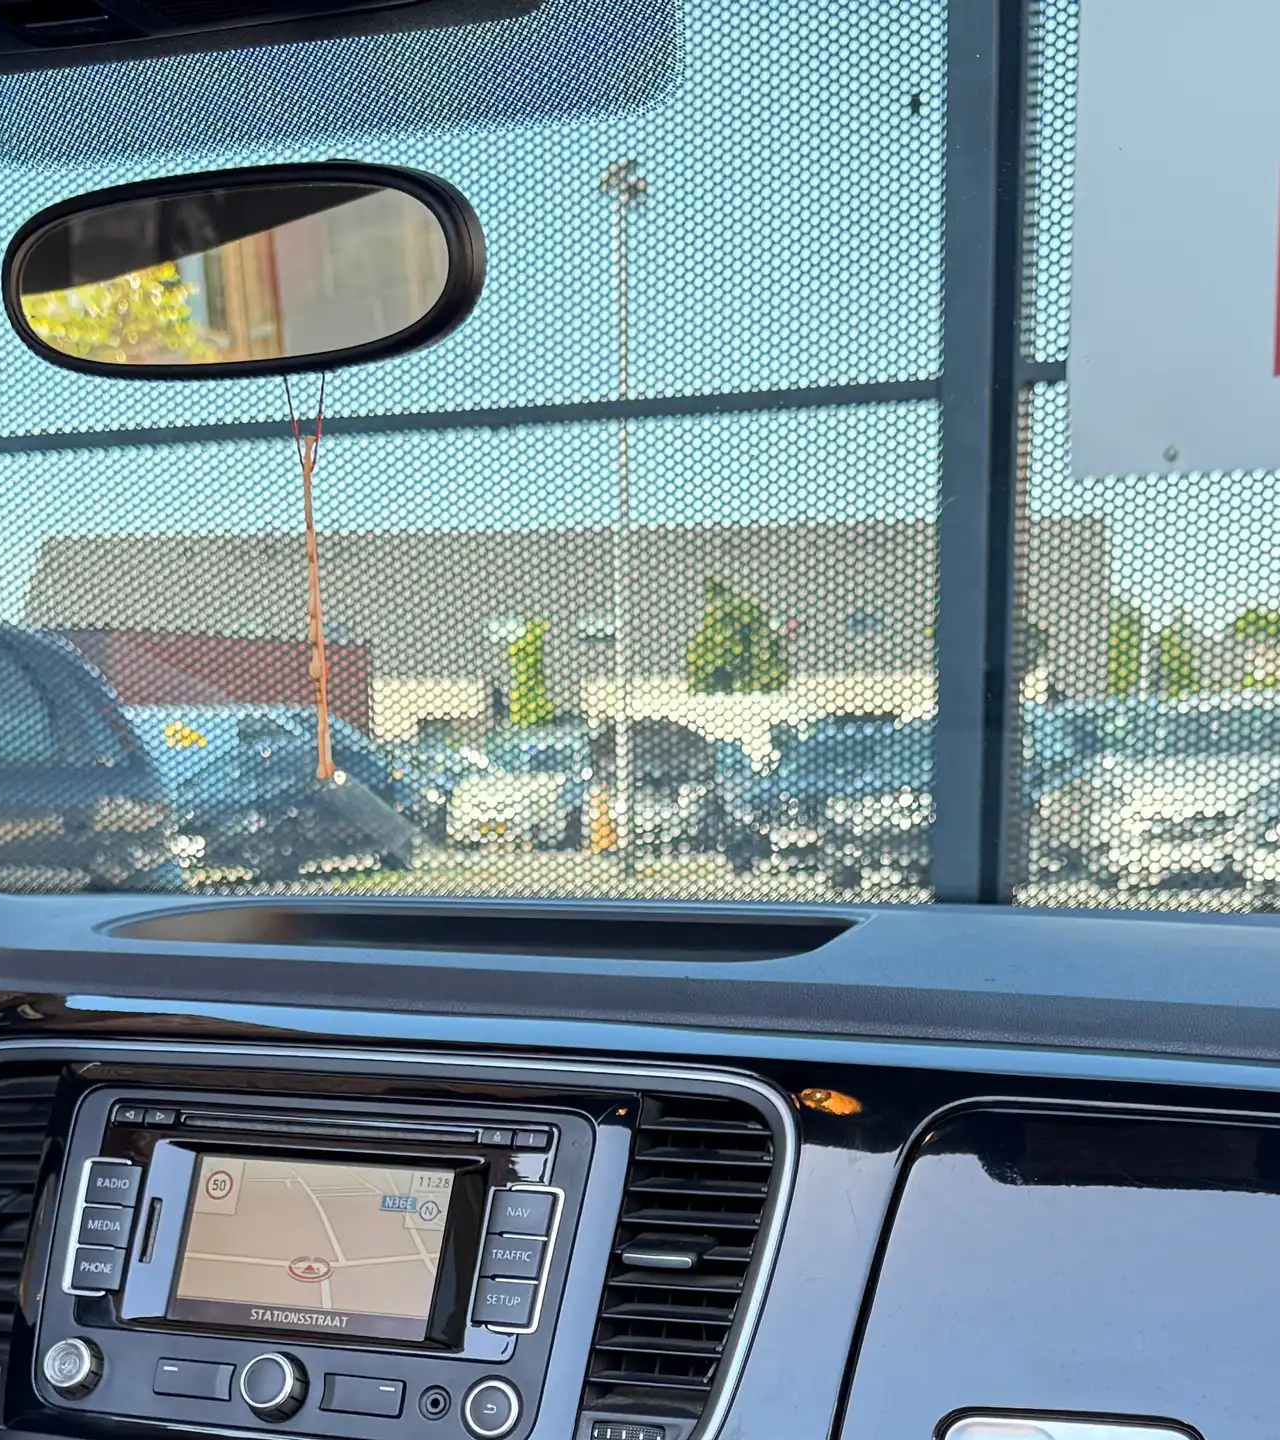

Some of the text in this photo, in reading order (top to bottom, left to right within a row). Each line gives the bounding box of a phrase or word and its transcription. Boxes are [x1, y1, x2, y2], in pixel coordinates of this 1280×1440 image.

[96, 1178, 130, 1189] RADIO
[212, 1178, 227, 1192] 50
[419, 1176, 451, 1189] 11:28
[506, 1207, 531, 1218] NAV
[87, 1220, 120, 1231] MEDIA
[491, 1249, 532, 1262] TRAFFIC
[80, 1262, 113, 1274] PHONE
[486, 1294, 521, 1306] SETUP
[249, 1309, 349, 1328] STATIONSSTRAAT
